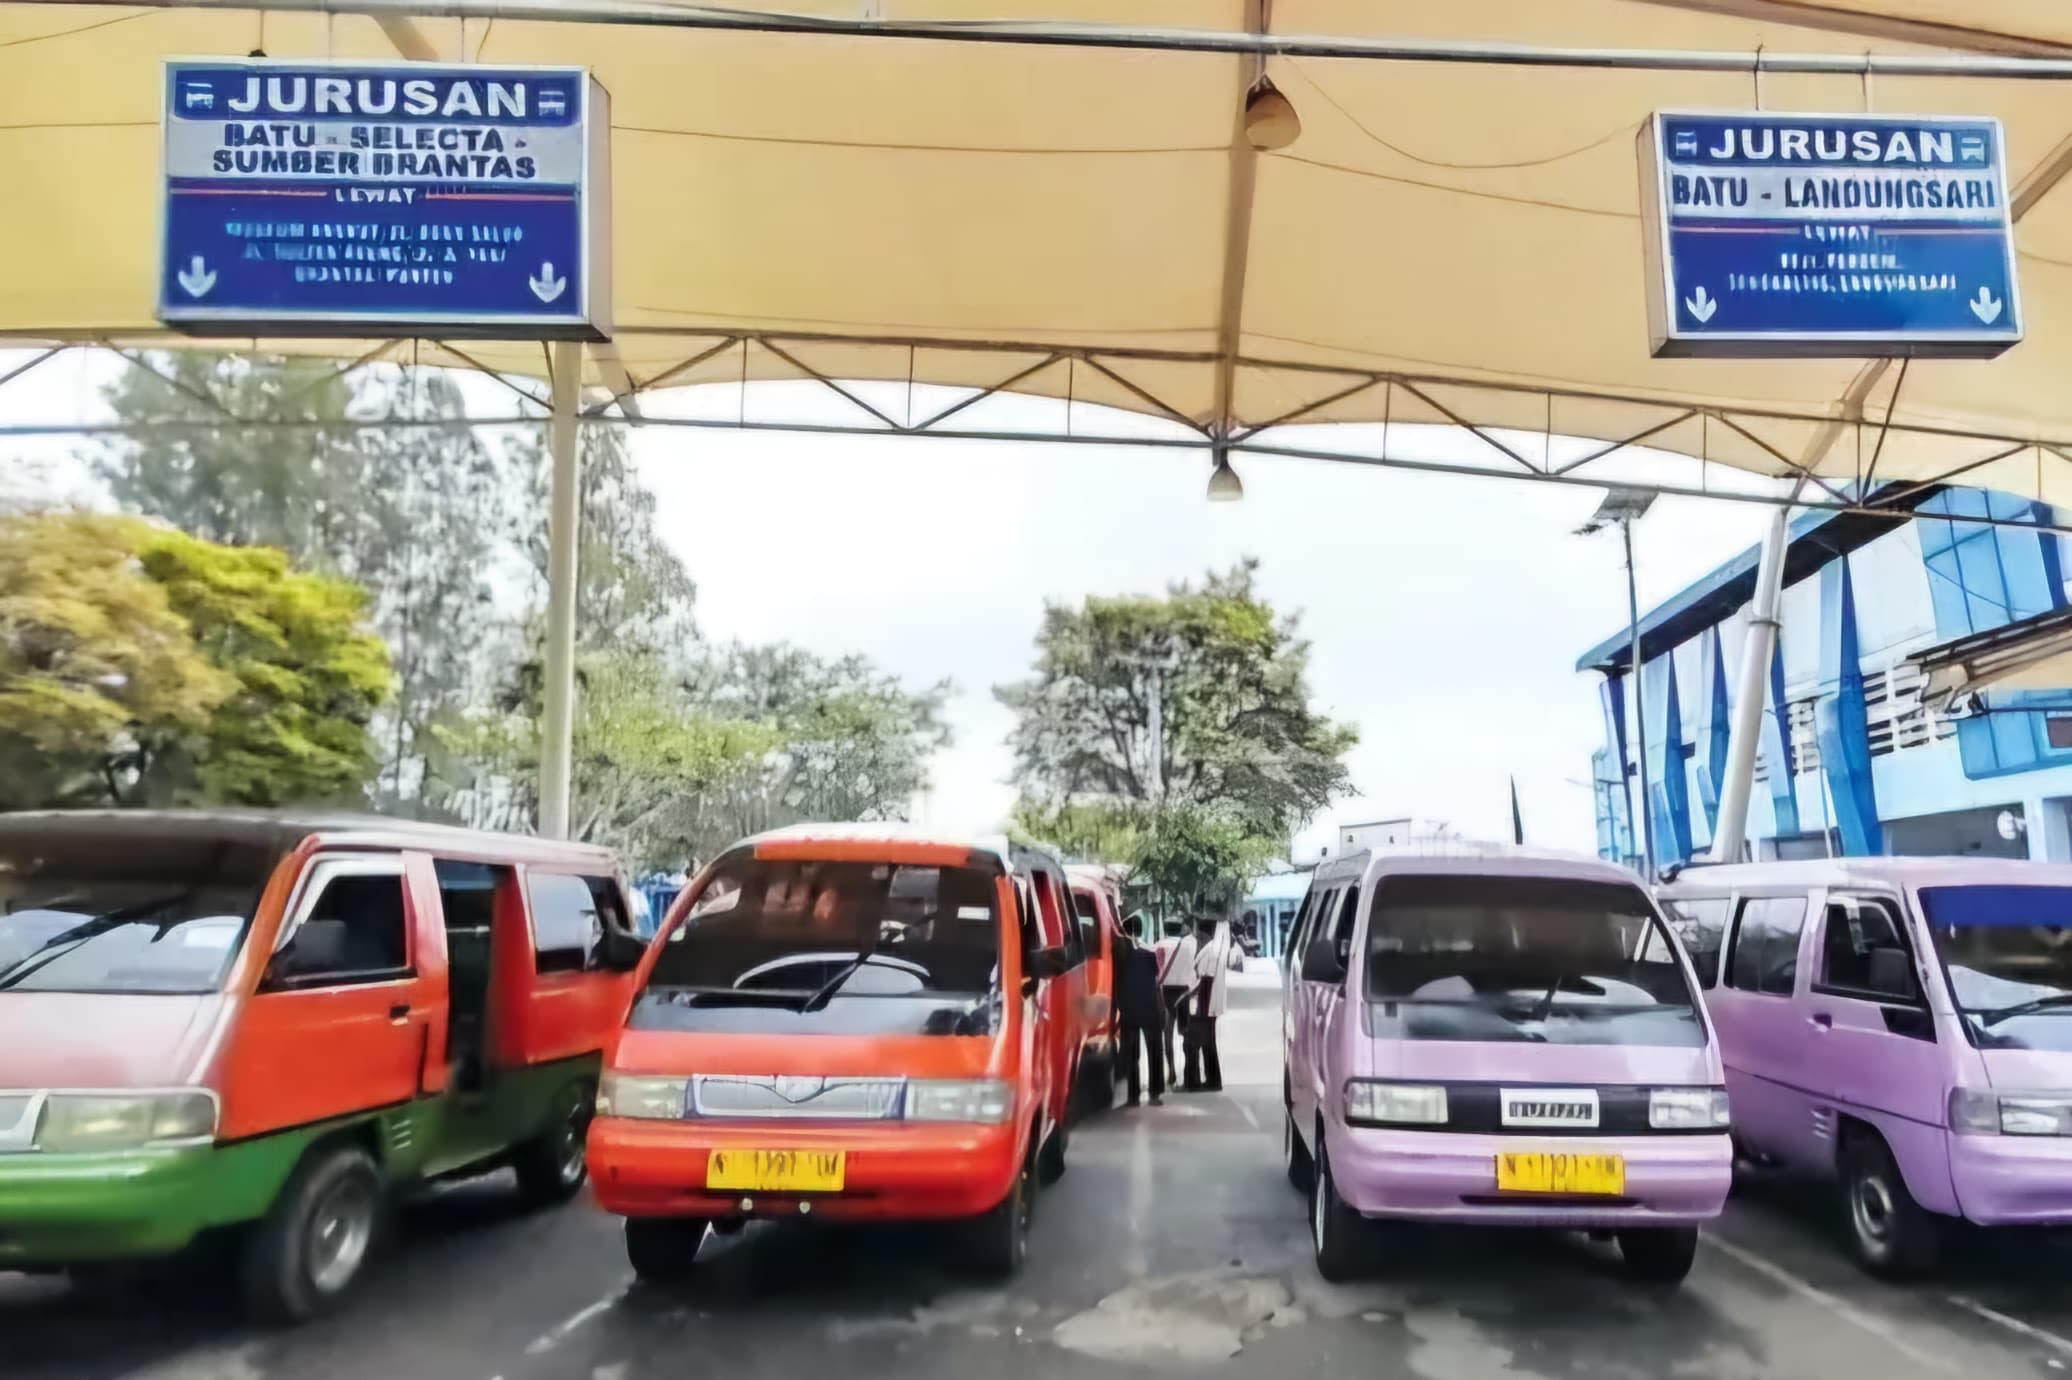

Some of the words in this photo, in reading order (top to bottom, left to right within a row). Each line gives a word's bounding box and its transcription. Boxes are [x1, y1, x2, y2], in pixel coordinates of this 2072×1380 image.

[228, 76, 526, 117] JURUSAN
[224, 123, 316, 147] BATU
[350, 126, 503, 151] SELECTA
[1710, 128, 1954, 163] JURUSAN
[213, 149, 360, 174] SUMBER
[372, 152, 536, 179] BRANTAS
[1672, 174, 1748, 206] BATU
